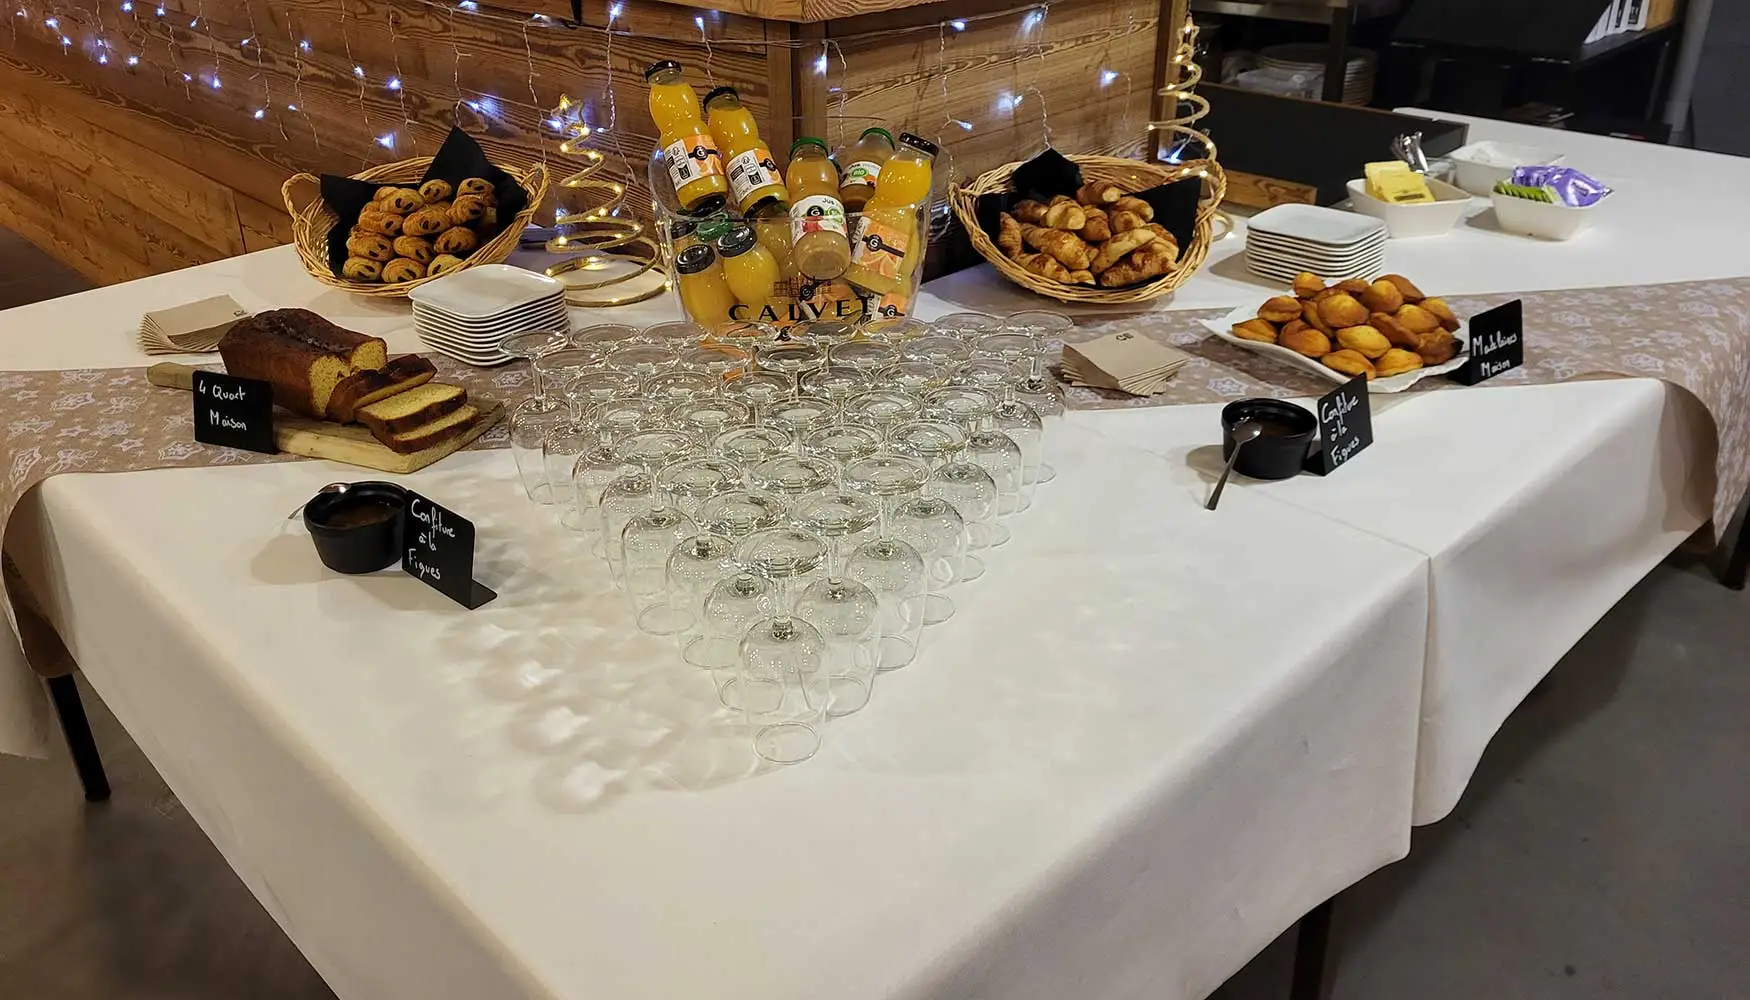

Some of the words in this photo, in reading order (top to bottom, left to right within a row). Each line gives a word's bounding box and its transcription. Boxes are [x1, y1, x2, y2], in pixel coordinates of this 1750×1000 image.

[1480, 359, 1511, 377] Maison
[199, 379, 206, 394] 4
[212, 384, 246, 401] Quart
[209, 408, 247, 431] Maison
[1330, 435, 1360, 466] Figues
[411, 498, 456, 539] Confiture
[408, 547, 441, 580] Figues
